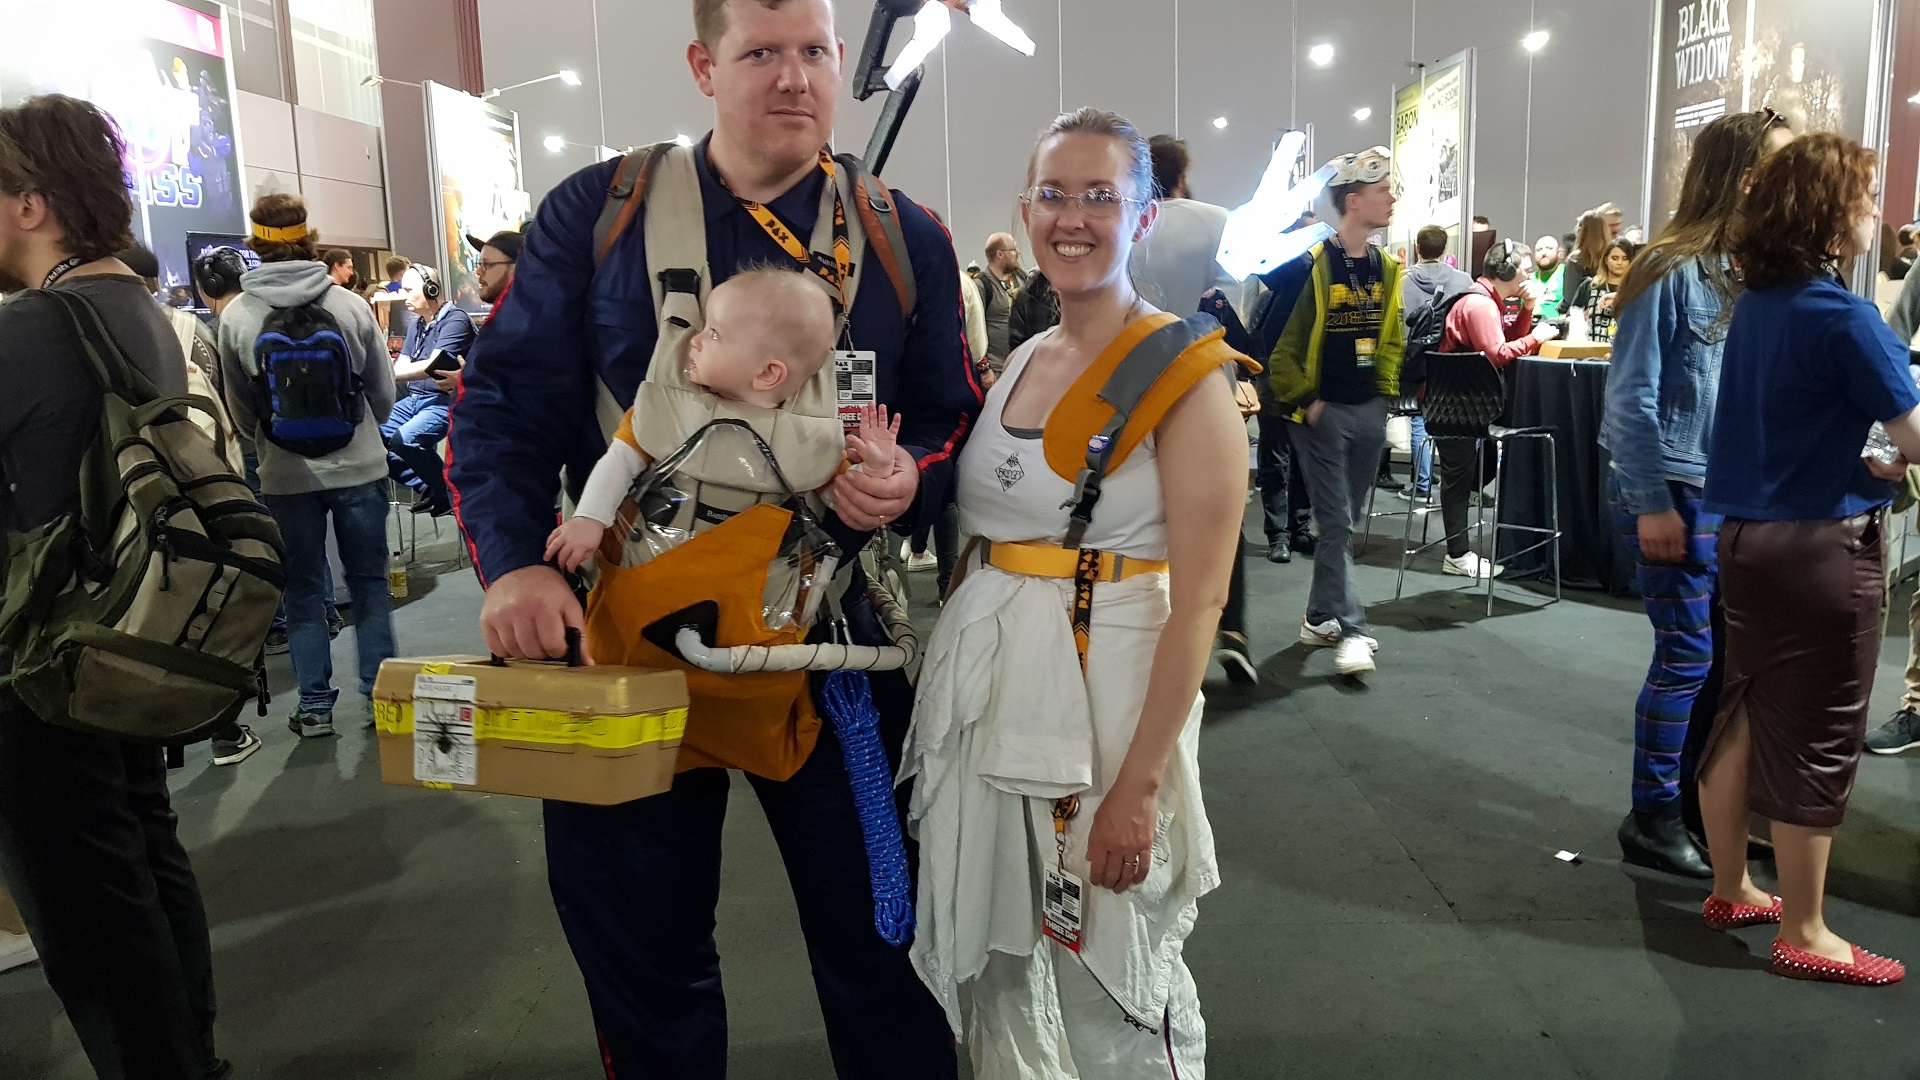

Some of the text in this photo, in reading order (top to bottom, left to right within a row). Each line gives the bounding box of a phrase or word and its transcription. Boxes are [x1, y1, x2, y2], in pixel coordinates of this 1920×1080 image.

[1677, 0, 1730, 48] BLACK
[1675, 34, 1733, 90] WIDOW
[1396, 108, 1419, 136] BARON
[764, 218, 789, 244] PAX
[1078, 583, 1091, 610] PAX
[1044, 917, 1067, 936] THREE
[1066, 930, 1078, 942] DAY
